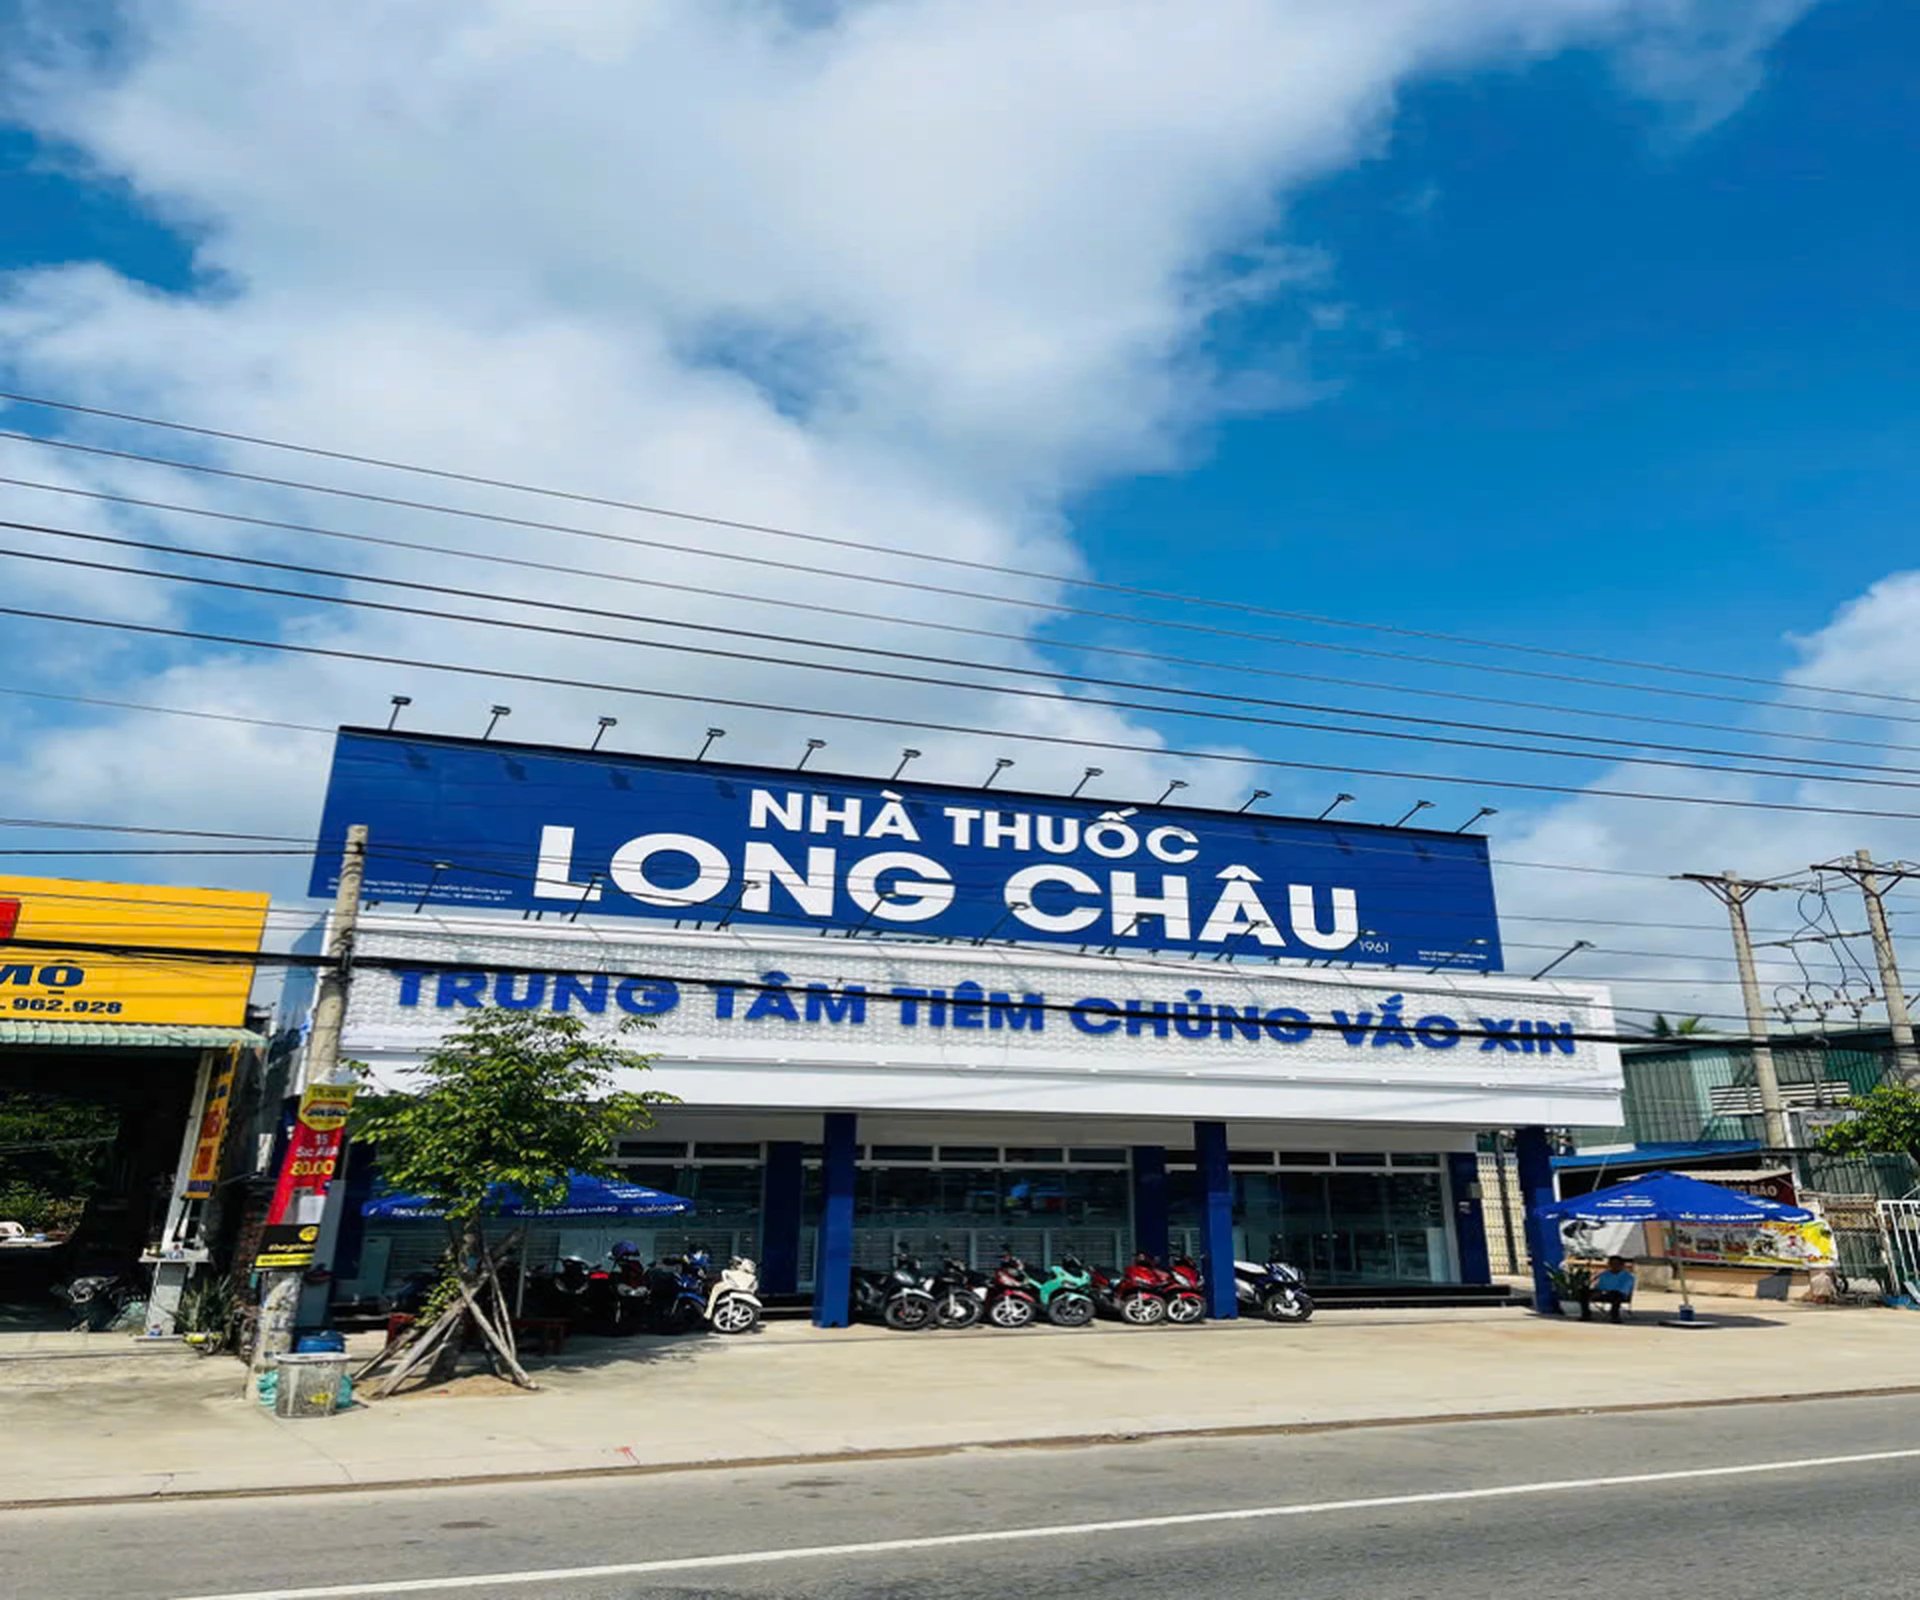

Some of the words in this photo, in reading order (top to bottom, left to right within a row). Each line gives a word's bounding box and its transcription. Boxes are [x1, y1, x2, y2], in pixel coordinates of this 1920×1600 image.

[750, 789, 921, 842] NHÀ
[943, 807, 1200, 864] THUỐC
[533, 825, 957, 923] LONG
[1003, 864, 1360, 951] CHÂU
[1359, 940, 1390, 954] 1961
[391, 967, 681, 1014] TRUNG
[706, 970, 868, 1025] TÂM
[891, 980, 1045, 1032] TIÊM
[1069, 989, 1312, 1043] CHỦNG
[1478, 1017, 1577, 1055] XIN
